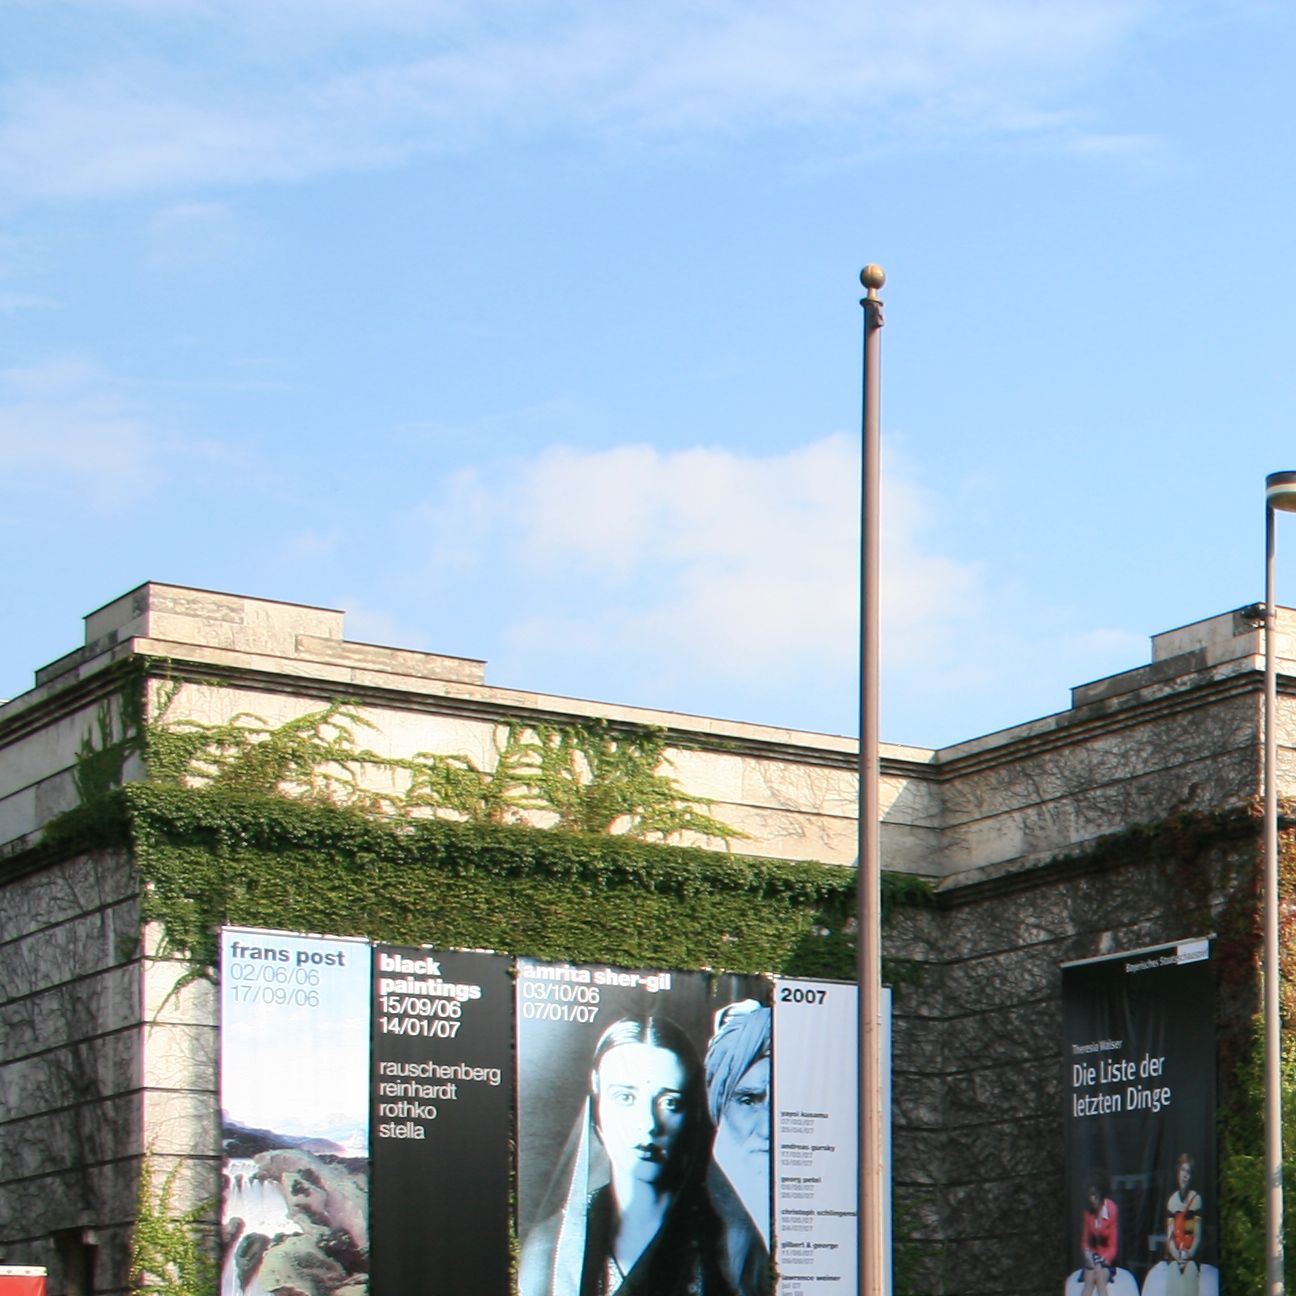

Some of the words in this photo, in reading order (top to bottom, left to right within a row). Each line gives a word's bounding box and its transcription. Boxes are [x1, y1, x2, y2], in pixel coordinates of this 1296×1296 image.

[231, 941, 289, 962] frans
[296, 949, 346, 967] post
[379, 953, 441, 976] black
[230, 963, 320, 986] 02/06/06
[523, 964, 592, 984] amrita
[594, 967, 671, 994] sher-gil
[231, 985, 320, 1007] 17/09/06
[379, 976, 482, 1000] paintings
[523, 982, 600, 1003] 03/10/06
[780, 987, 827, 1005] 2007
[380, 997, 462, 1018] 15/09/06
[523, 1002, 599, 1023] 07/01/07
[380, 1018, 461, 1038] 14/01/07
[380, 1061, 501, 1086] rauschenberg
[1073, 1062, 1096, 1087] Die
[1100, 1059, 1136, 1083] Liste
[1140, 1053, 1165, 1078] der
[380, 1080, 458, 1100] reinhardt
[1073, 1093, 1121, 1117] letzten
[1127, 1085, 1171, 1112] Dinge
[379, 1101, 437, 1120] rothko
[379, 1122, 425, 1140] stella
